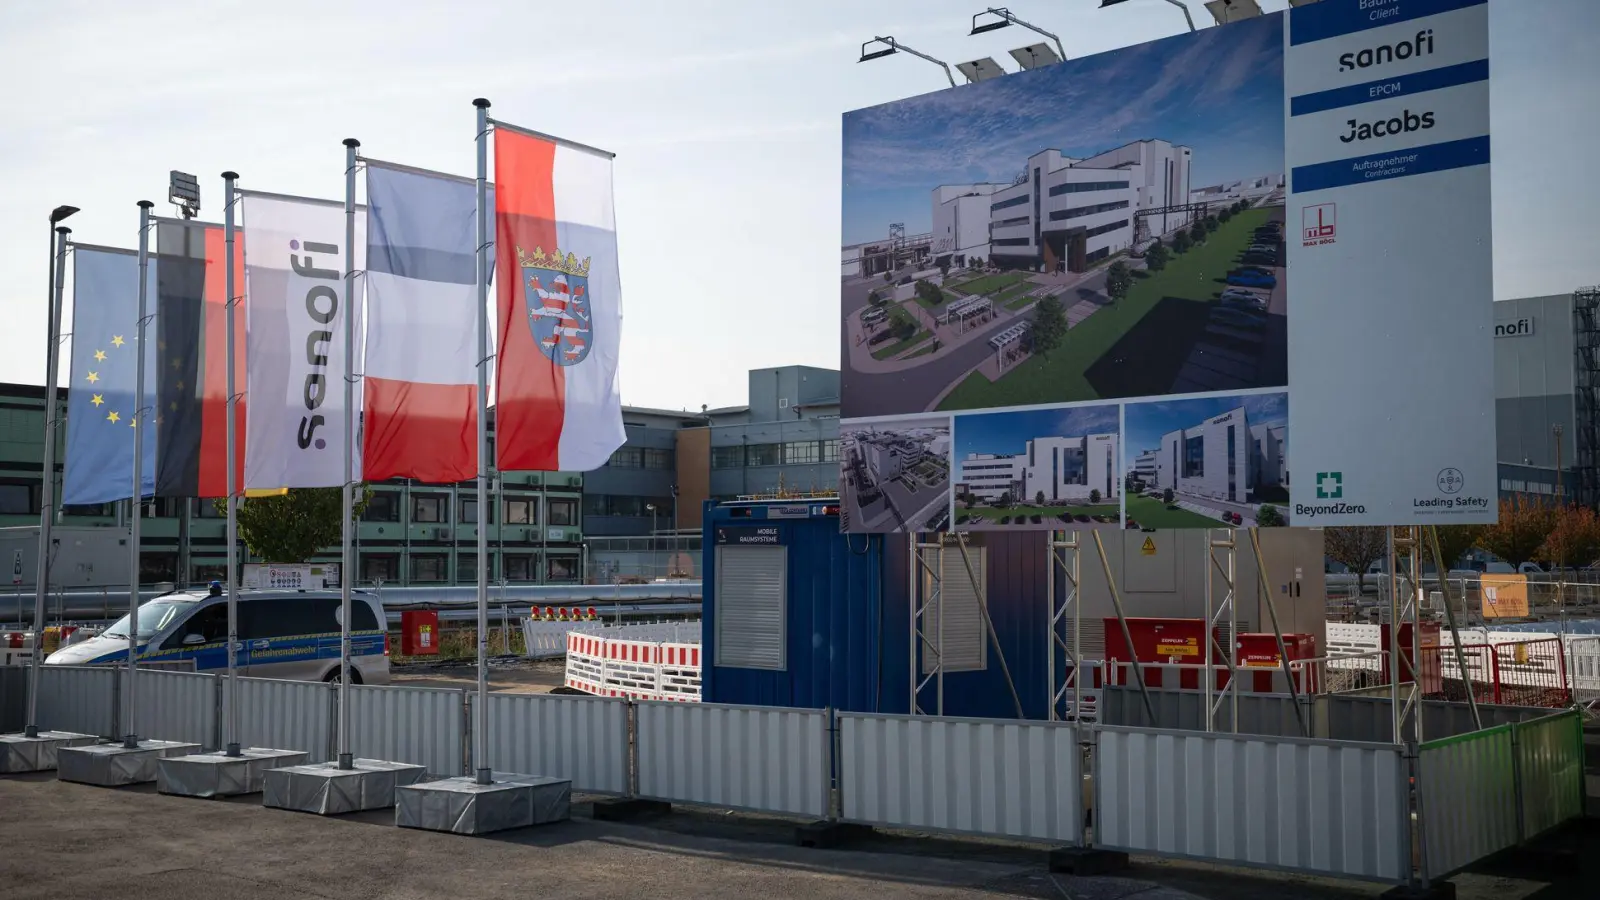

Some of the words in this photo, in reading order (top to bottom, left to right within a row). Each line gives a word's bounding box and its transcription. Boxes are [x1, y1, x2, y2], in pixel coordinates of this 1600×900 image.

[1359, 0, 1399, 10] Bau
[1369, 5, 1400, 21] Client
[1339, 28, 1434, 73] sanofi
[1369, 82, 1401, 97] EPCM
[1339, 109, 1436, 144] Jacobs
[1352, 153, 1419, 172] Auftragnehmer
[1364, 166, 1406, 179] Contractors
[1495, 319, 1529, 336] nofi
[290, 239, 340, 450] sanofi
[1413, 497, 1453, 509] Leading
[1455, 496, 1489, 508] Safety
[251, 646, 317, 659] Gefahrenabwehr
